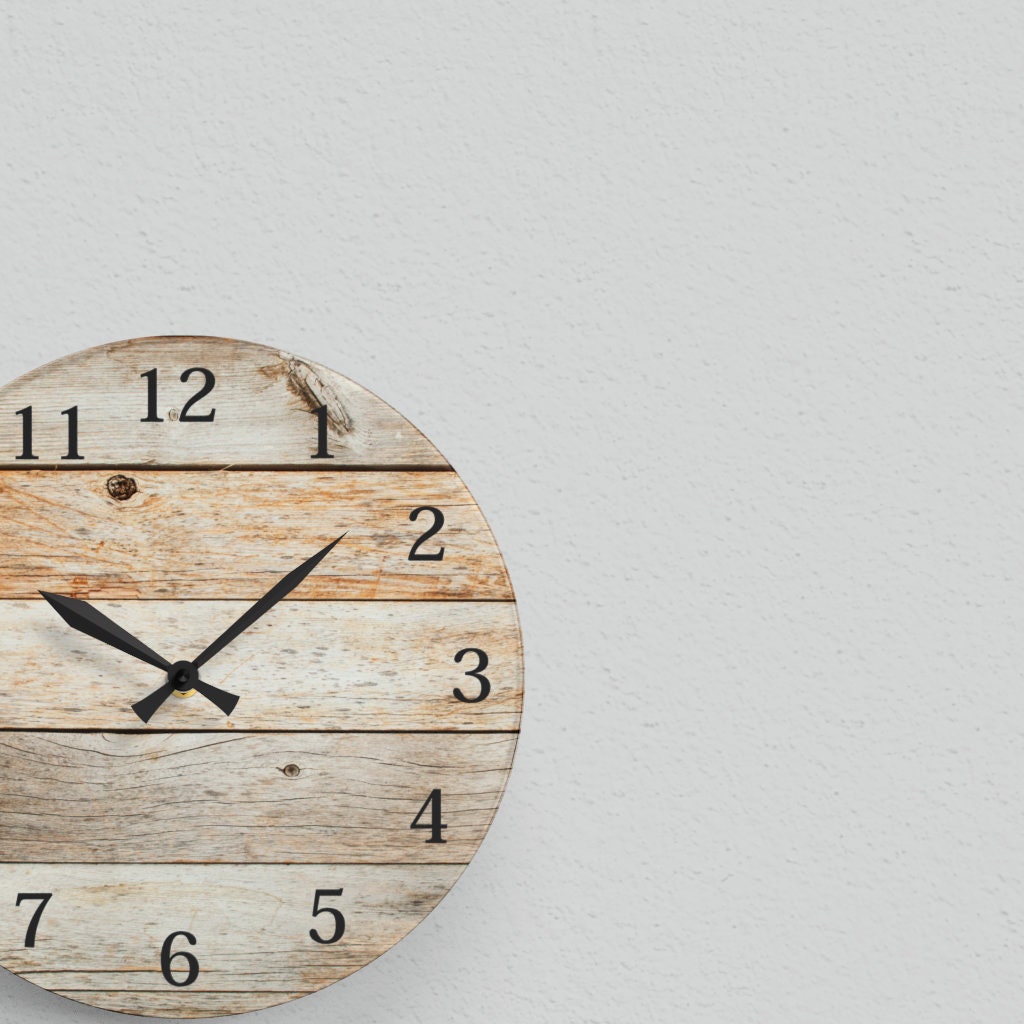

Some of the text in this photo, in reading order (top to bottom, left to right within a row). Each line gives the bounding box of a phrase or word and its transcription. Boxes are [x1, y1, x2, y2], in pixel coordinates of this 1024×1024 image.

[140, 367, 216, 423] 12
[14, 405, 85, 460] 11
[311, 404, 334, 459] 1
[408, 505, 445, 561] 2
[453, 648, 491, 704] 3
[410, 788, 448, 844] 4
[15, 893, 53, 948] 7
[309, 888, 346, 945] 5
[160, 931, 200, 987] 6
